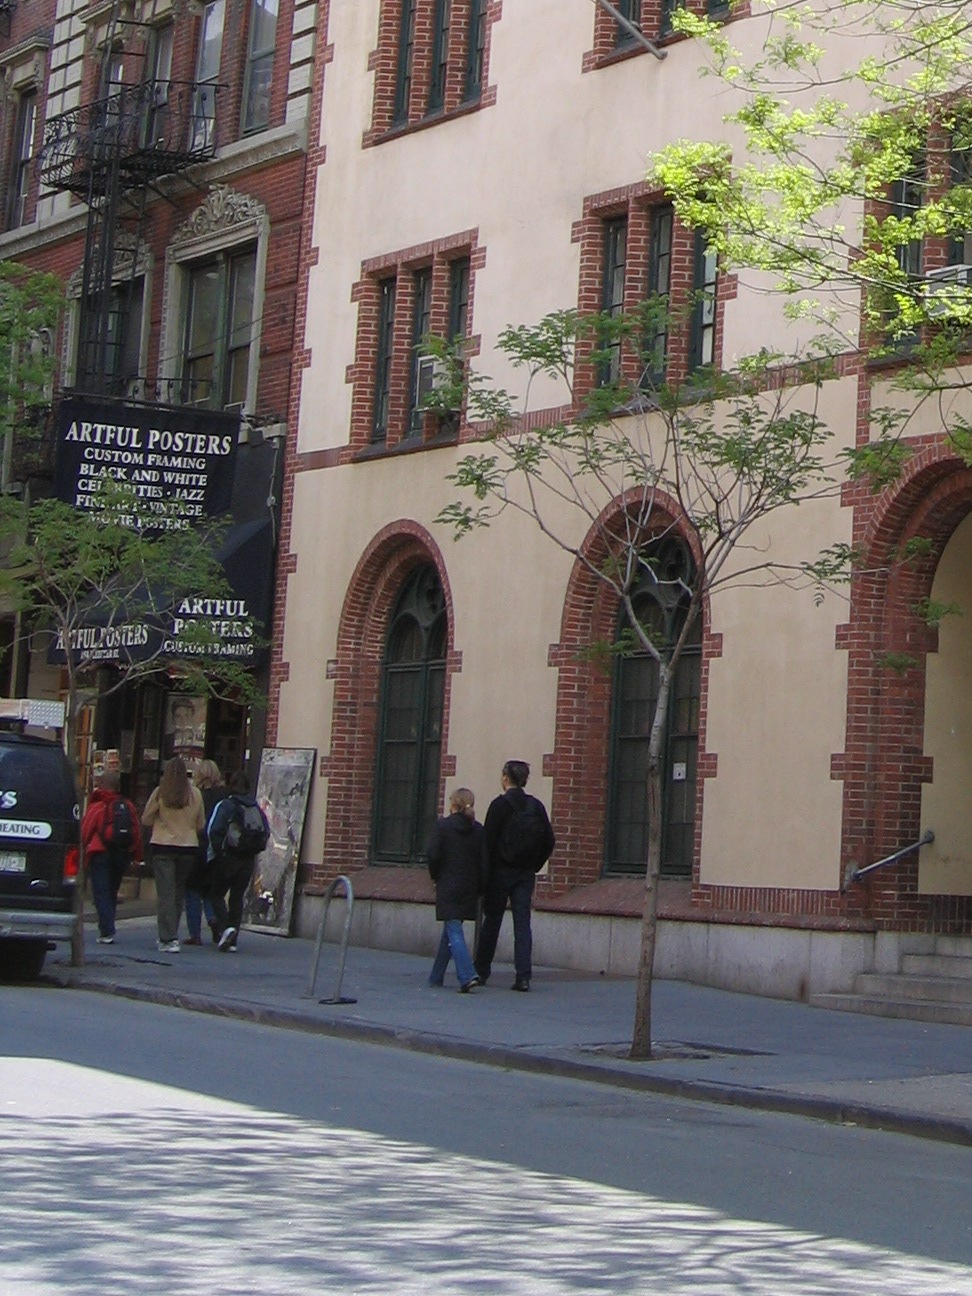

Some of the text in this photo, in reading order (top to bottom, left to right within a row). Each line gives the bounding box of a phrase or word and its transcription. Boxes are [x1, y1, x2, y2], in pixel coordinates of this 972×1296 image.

[65, 421, 232, 455] ARTFUL POSTERS
[84, 447, 206, 469] CUSTOM FRAMING
[79, 463, 208, 486] BLACK AND WHITE
[175, 488, 205, 501] JAZZ
[149, 502, 203, 517] VINTAGE
[178, 598, 249, 616] ARTFUL
